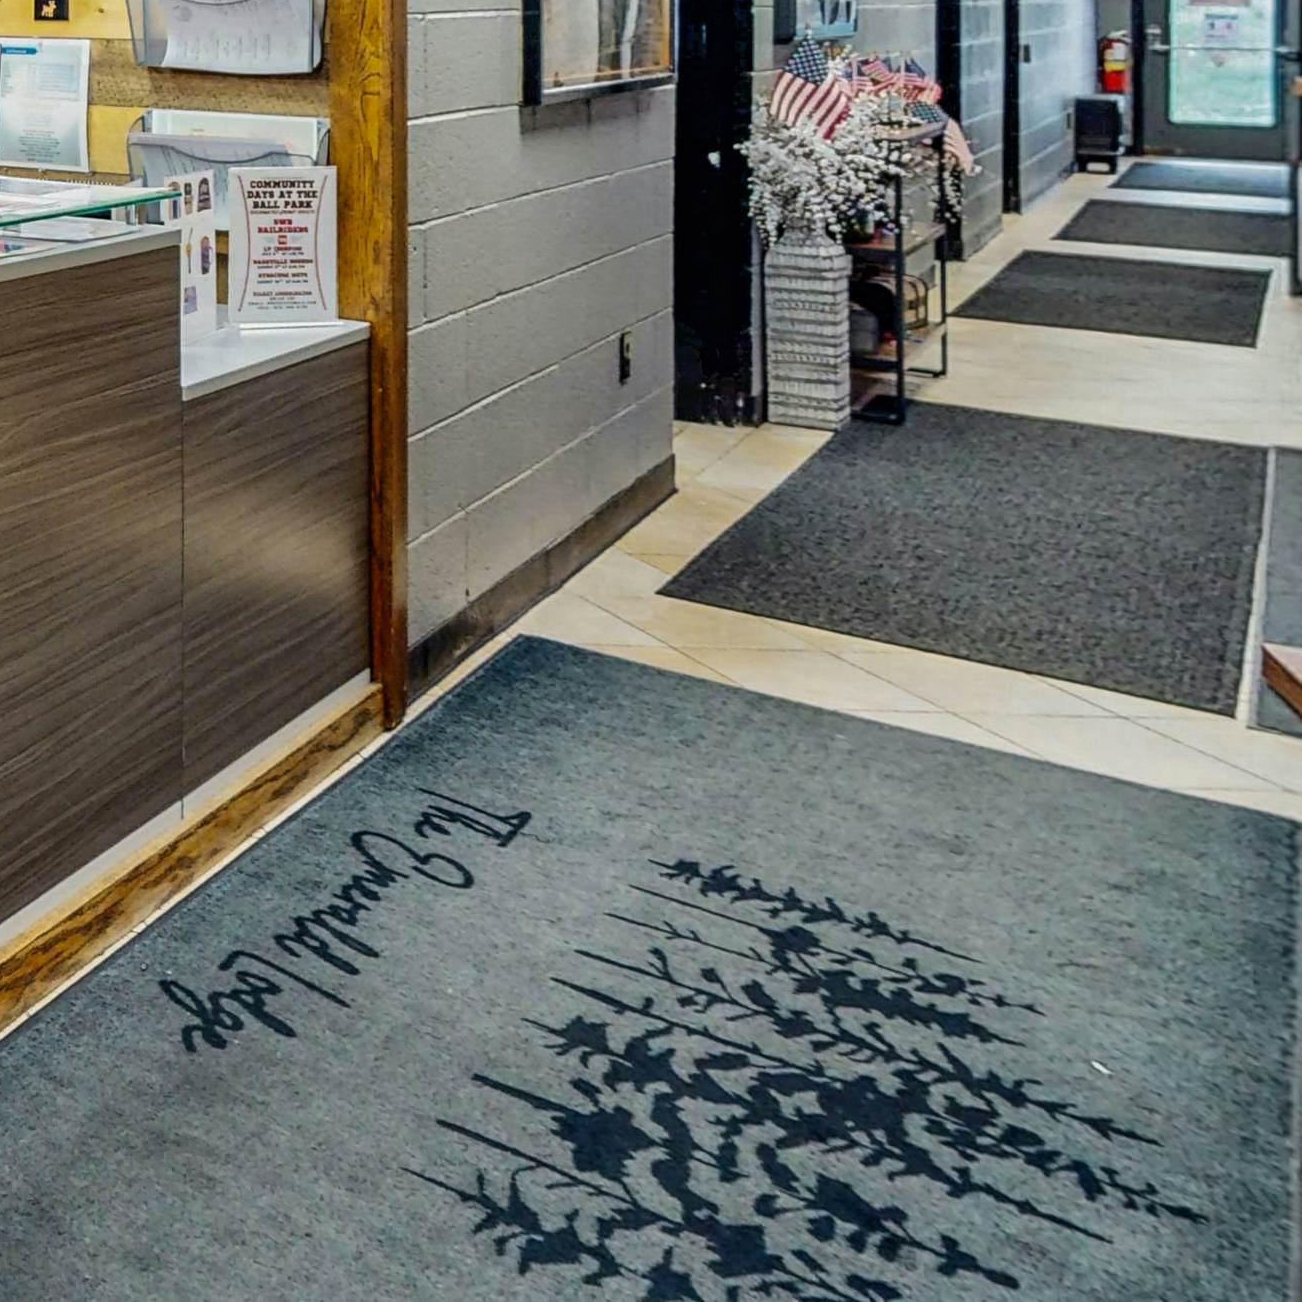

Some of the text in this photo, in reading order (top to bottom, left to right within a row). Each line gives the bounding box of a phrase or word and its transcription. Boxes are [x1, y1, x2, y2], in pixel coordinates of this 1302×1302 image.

[250, 180, 315, 189] COMMUNITY
[247, 190, 318, 199] DAYS AT THE
[253, 200, 313, 209] BALL PARK
[158, 787, 533, 1053] The Emerald Lodge
